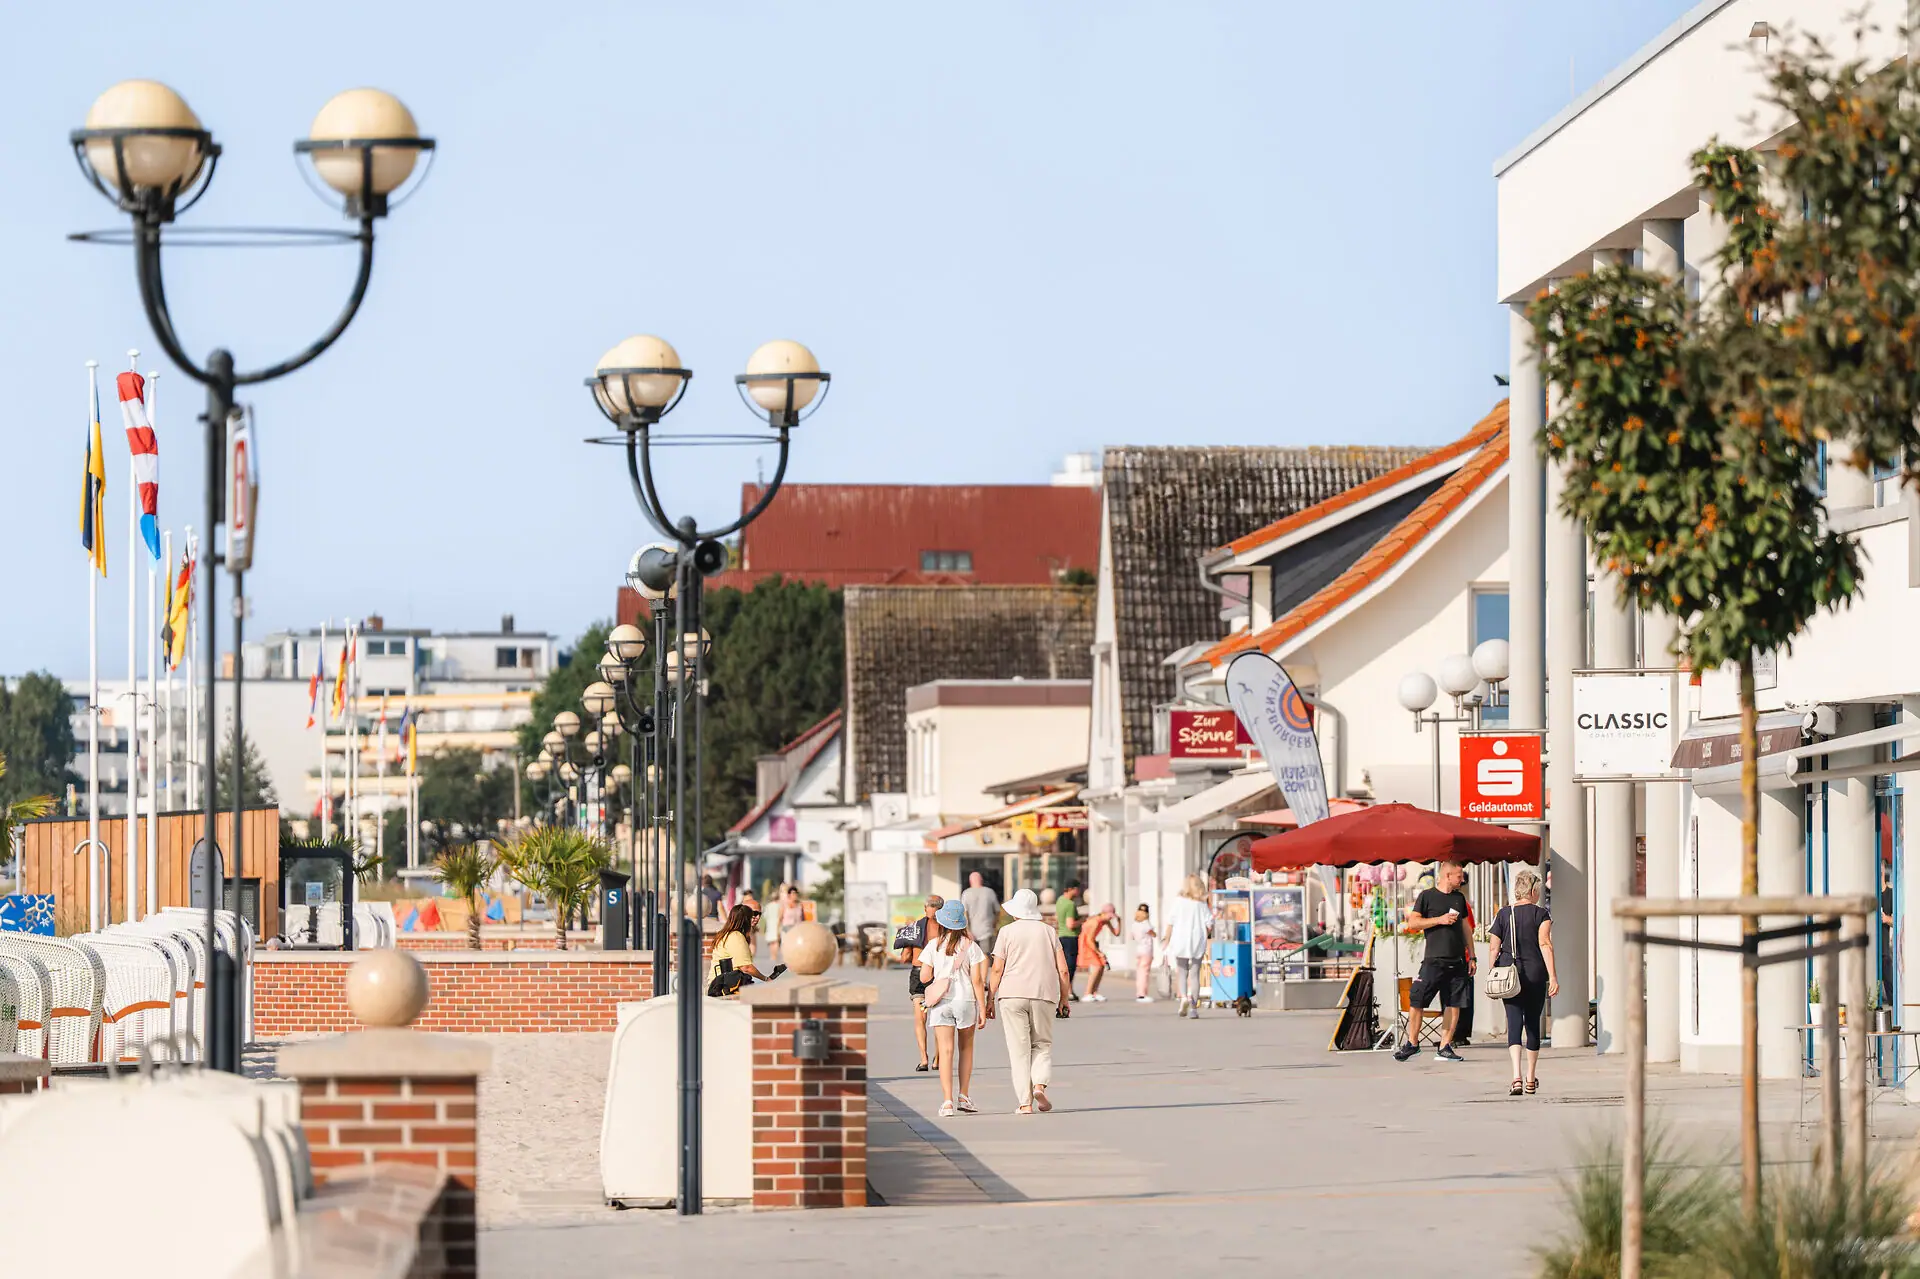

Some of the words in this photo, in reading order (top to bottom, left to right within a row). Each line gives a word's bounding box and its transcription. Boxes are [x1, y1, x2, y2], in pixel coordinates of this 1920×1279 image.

[1192, 714, 1221, 727] Zur
[1577, 712, 1668, 730] CLASSIC
[1178, 727, 1234, 746] Sonne
[1468, 801, 1533, 813] Geldautomat
[608, 890, 618, 905] S
